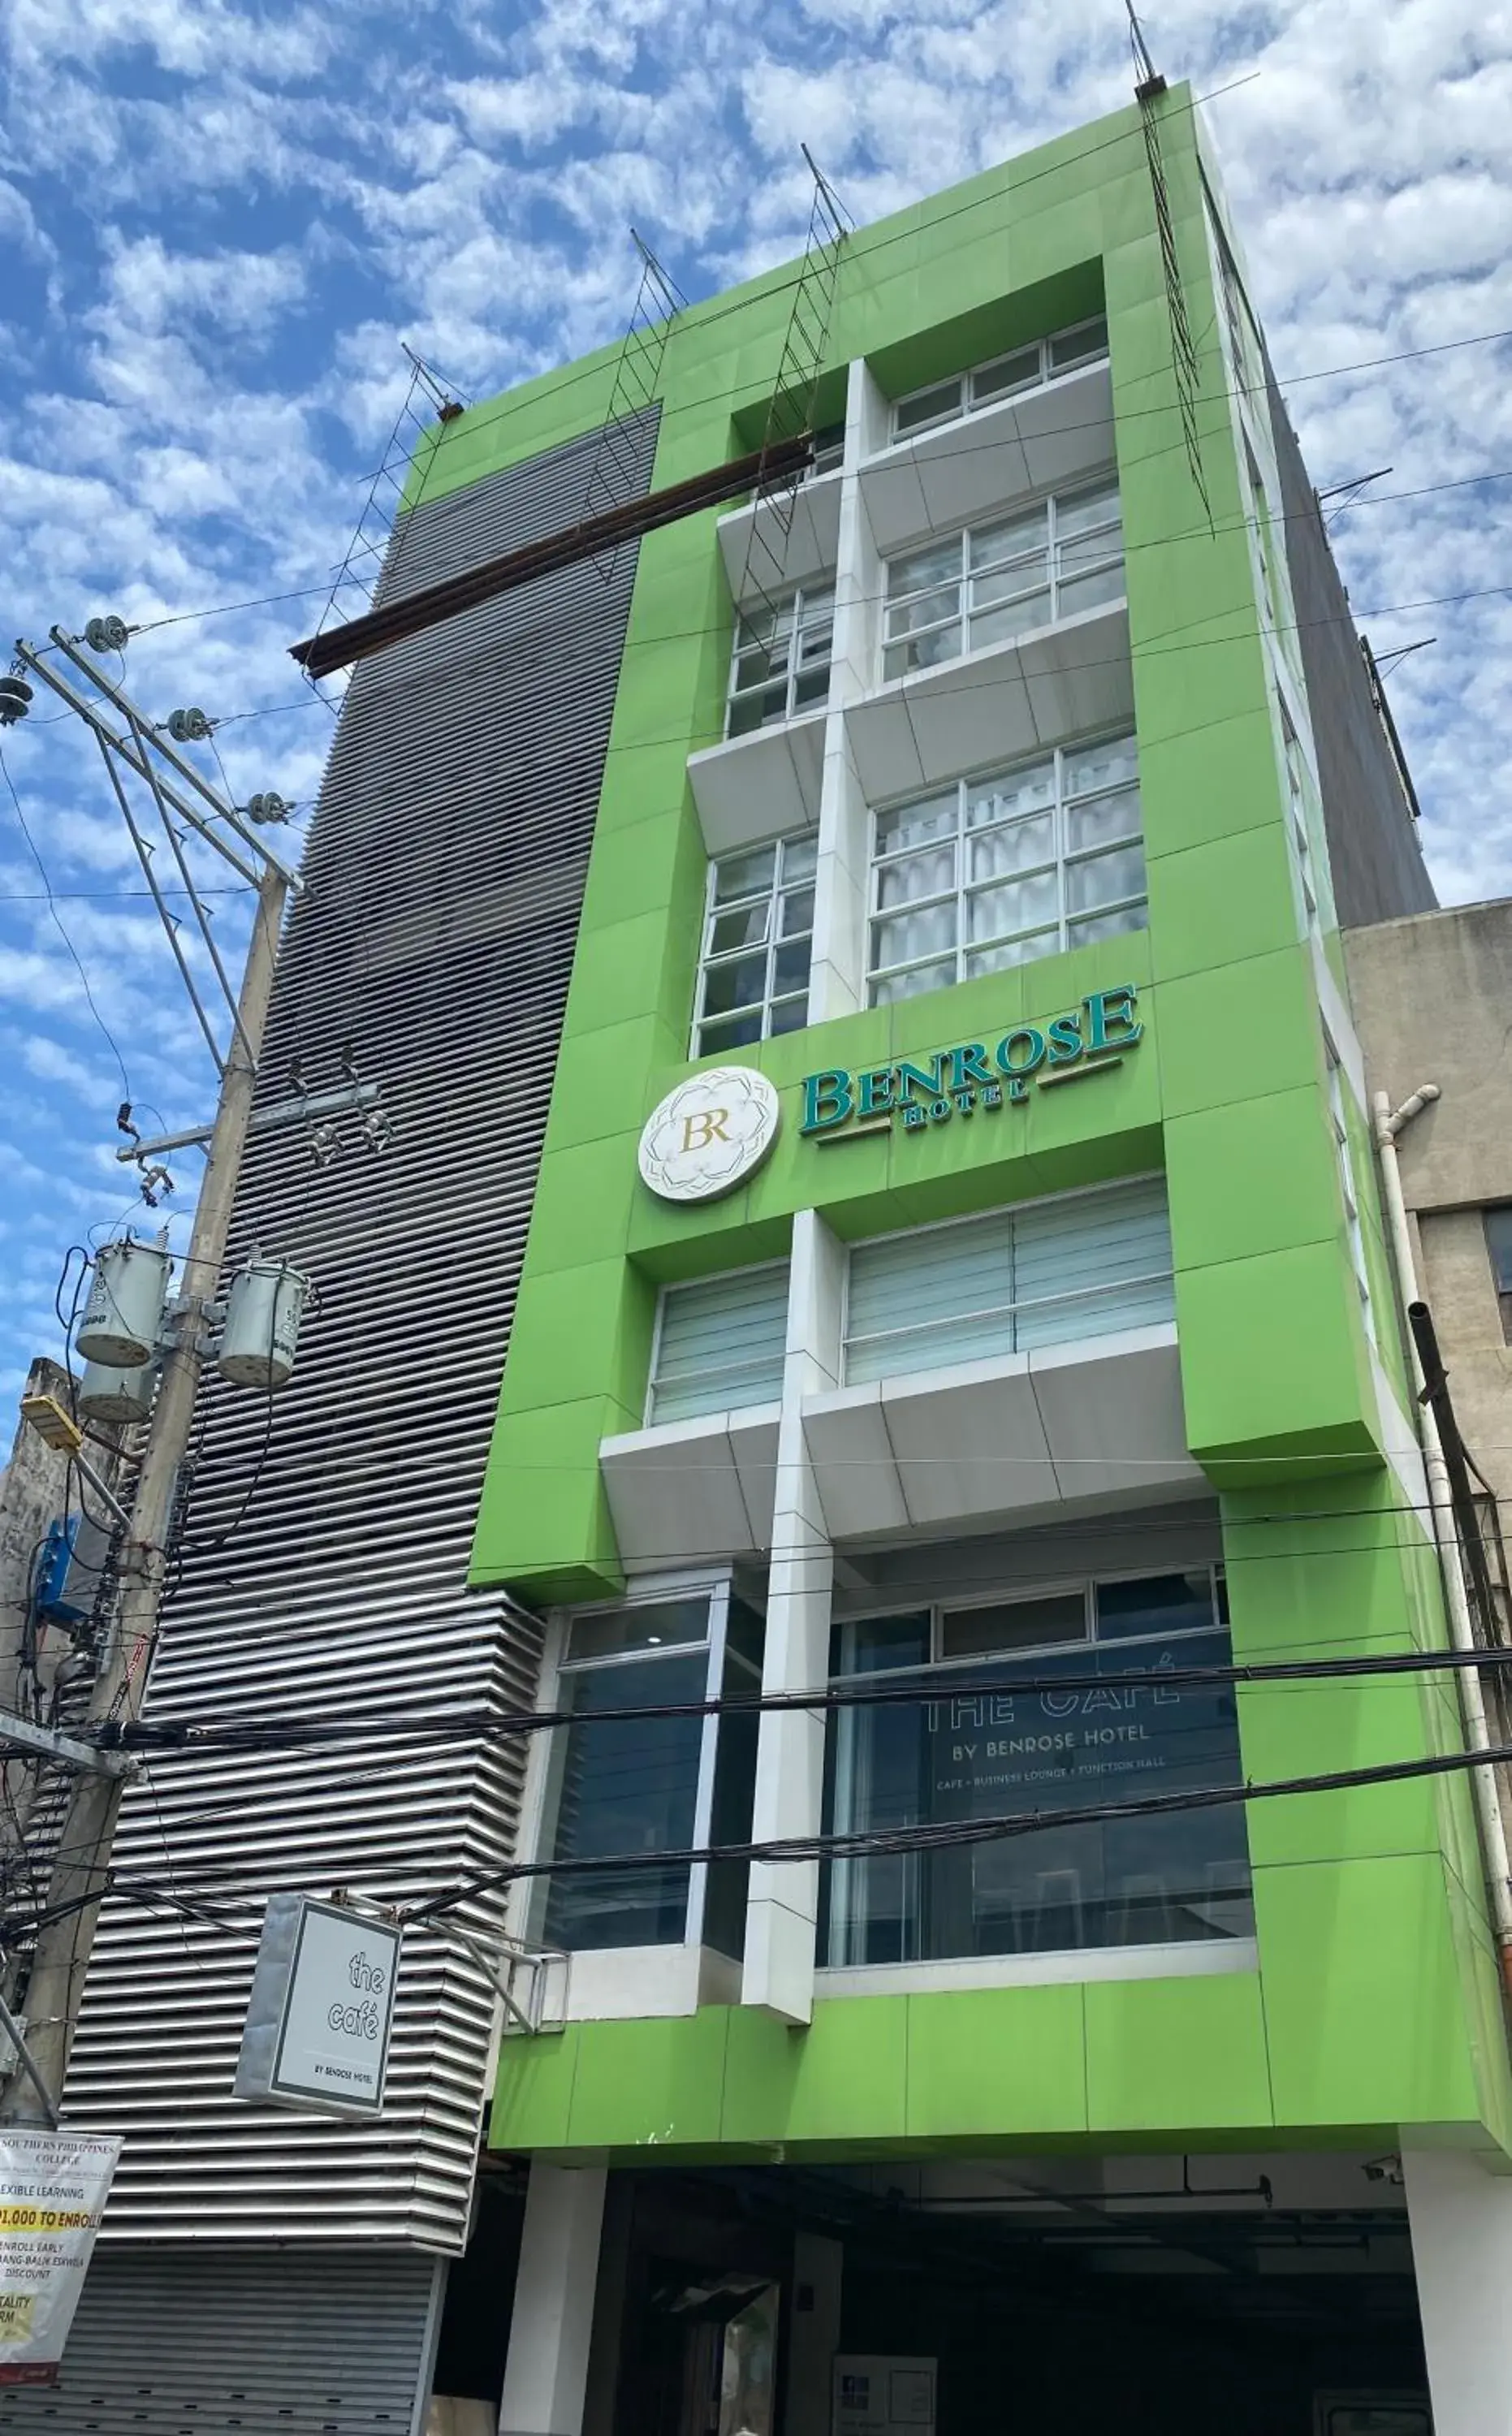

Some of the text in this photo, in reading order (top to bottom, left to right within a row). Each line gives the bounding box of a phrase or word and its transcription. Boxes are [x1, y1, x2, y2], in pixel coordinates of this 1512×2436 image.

[797, 983, 1144, 1136] BENROSE
[904, 1077, 1030, 1129] HOTEL
[678, 1107, 734, 1155] BR
[921, 1691, 1014, 1732] THE
[953, 1725, 1151, 1761] BY BENROSE HOTEL
[974, 1773, 1023, 1787] BUSINESS
[1024, 1769, 1067, 1781] LOUNGE
[1078, 1761, 1133, 1774] FUNCTION
[1136, 1757, 1166, 1768] HALL
[349, 1951, 385, 1995] the
[328, 2000, 379, 2040] café
[37, 2186, 84, 2200] LEARNING
[41, 2211, 56, 2226] TO
[5, 2269, 50, 2279] DISCOUNT
